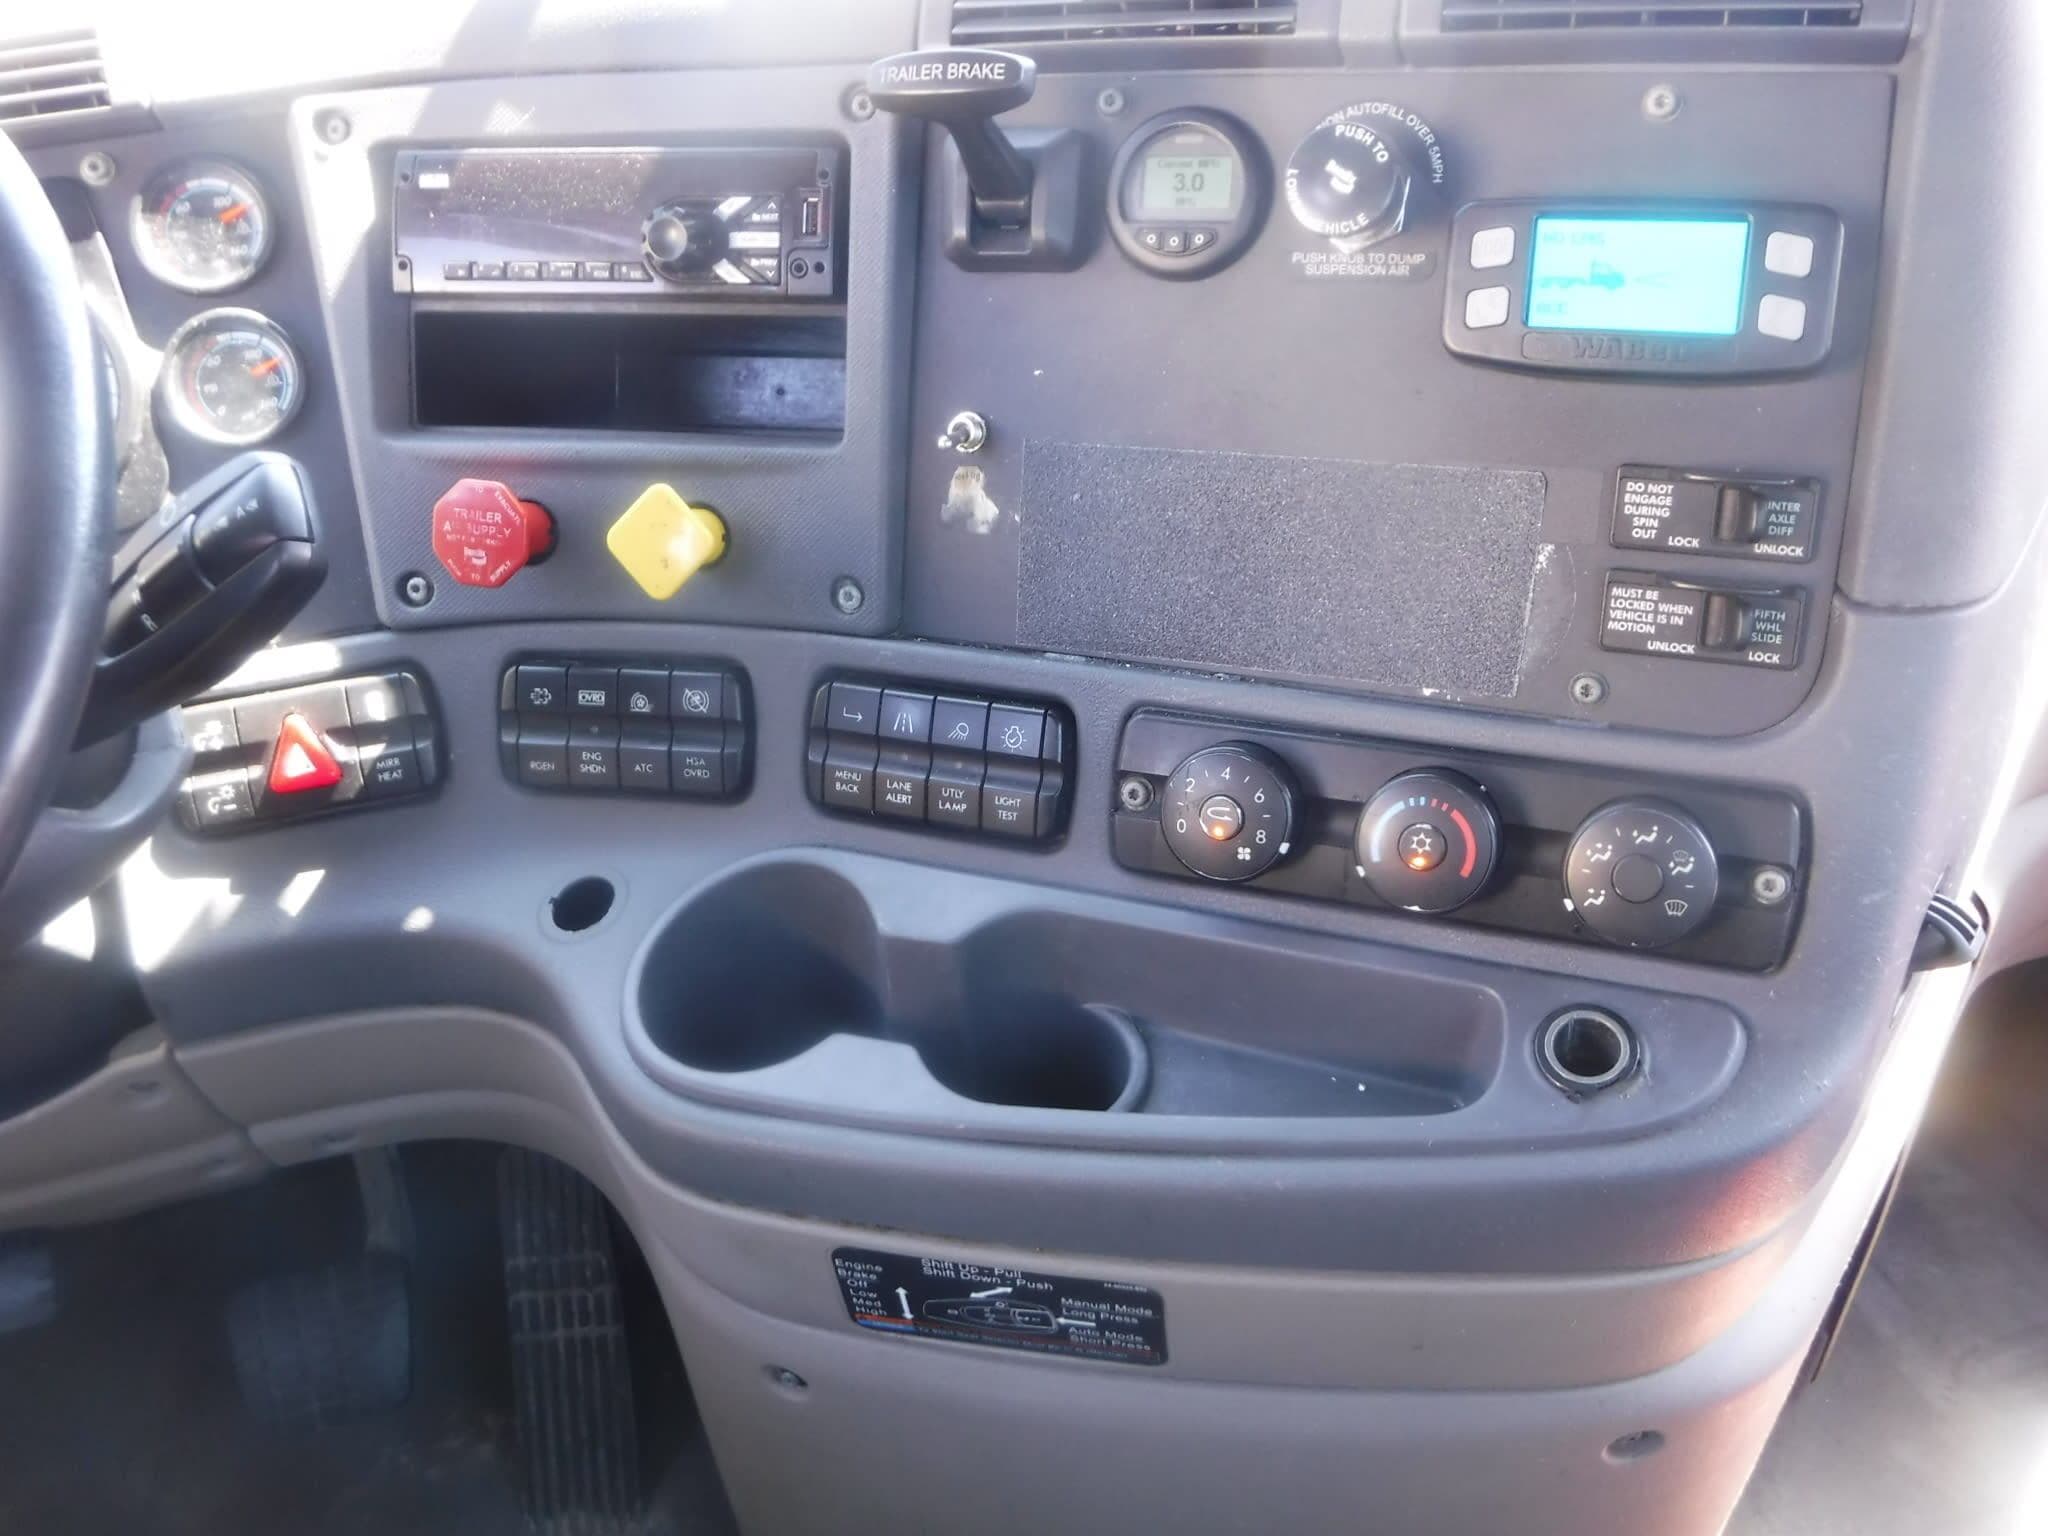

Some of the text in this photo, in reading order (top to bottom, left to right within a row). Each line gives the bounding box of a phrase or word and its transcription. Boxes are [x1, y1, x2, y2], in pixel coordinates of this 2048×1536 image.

[880, 62, 1006, 83] TRAILER BRAKE
[1346, 101, 1405, 121] AUTOFILL
[1406, 114, 1436, 148] OVER
[1334, 124, 1389, 163] PUSH TO
[1172, 172, 1205, 192] 3.0
[1291, 252, 1327, 264] PUSH
[1368, 252, 1385, 264] TO
[1388, 252, 1426, 265] DUMP
[1305, 264, 1411, 276] SUSPENSION AIR
[1626, 482, 1674, 495] DO NOT
[1624, 493, 1673, 506] ENGAGE
[1624, 505, 1671, 518] DURING
[1767, 500, 1801, 513] INTER
[453, 507, 502, 524] TRAILER
[1632, 516, 1660, 528] SPIN
[1768, 514, 1796, 525] AXLE
[1631, 527, 1658, 540] OUT
[1768, 525, 1795, 537] DIFF
[1668, 536, 1700, 548] LOCK
[1754, 543, 1804, 557] UNLOCK
[1611, 586, 1660, 601] MUST BE
[1610, 598, 1694, 616] LOCKED WHEN
[1609, 610, 1684, 626] VEHICLE IS IN
[1754, 609, 1786, 621] FIFTH
[1607, 621, 1656, 635] MOTION
[1755, 621, 1782, 633] WHL
[1751, 632, 1784, 645] SLIDE
[1647, 640, 1696, 655] UNLOCK
[1748, 651, 1781, 665] LOCK
[582, 751, 602, 762] ENG
[686, 756, 706, 767] HSA
[376, 757, 401, 770] MIRR
[530, 760, 555, 772] RGEN
[580, 763, 606, 774] SHDN
[634, 763, 654, 773] ATC
[377, 769, 403, 782] HEAT
[683, 768, 710, 778] OVRD
[835, 770, 862, 782] MENU
[1220, 767, 1231, 780] 4
[835, 782, 860, 794] BACK
[886, 779, 913, 792] LANE
[1185, 778, 1196, 793] 2
[885, 792, 913, 806] ALERT
[942, 787, 965, 799] UTLY
[1254, 788, 1265, 803] 6
[938, 800, 967, 813] LAMP
[994, 796, 1022, 808] LIGHT
[997, 809, 1019, 822] TEST
[1176, 819, 1187, 834] 0
[1255, 829, 1266, 844] 8
[834, 1258, 884, 1273] Engine
[921, 1258, 953, 1270] Shift
[958, 1263, 978, 1274] Up
[994, 1267, 1022, 1279] Pull
[837, 1267, 878, 1281] Brake
[922, 1267, 955, 1279] Shift
[960, 1271, 1001, 1284] Down
[1016, 1278, 1053, 1291] Push
[847, 1279, 868, 1288] Off
[849, 1288, 878, 1298] Low
[852, 1297, 882, 1308] Med
[1061, 1297, 1153, 1316] Manual Mode
[855, 1305, 888, 1316] High
[1062, 1307, 1139, 1325] Long Press
[1068, 1326, 1144, 1342] Auto Mode
[1070, 1334, 1106, 1346] Short
[1111, 1338, 1151, 1351] Press
